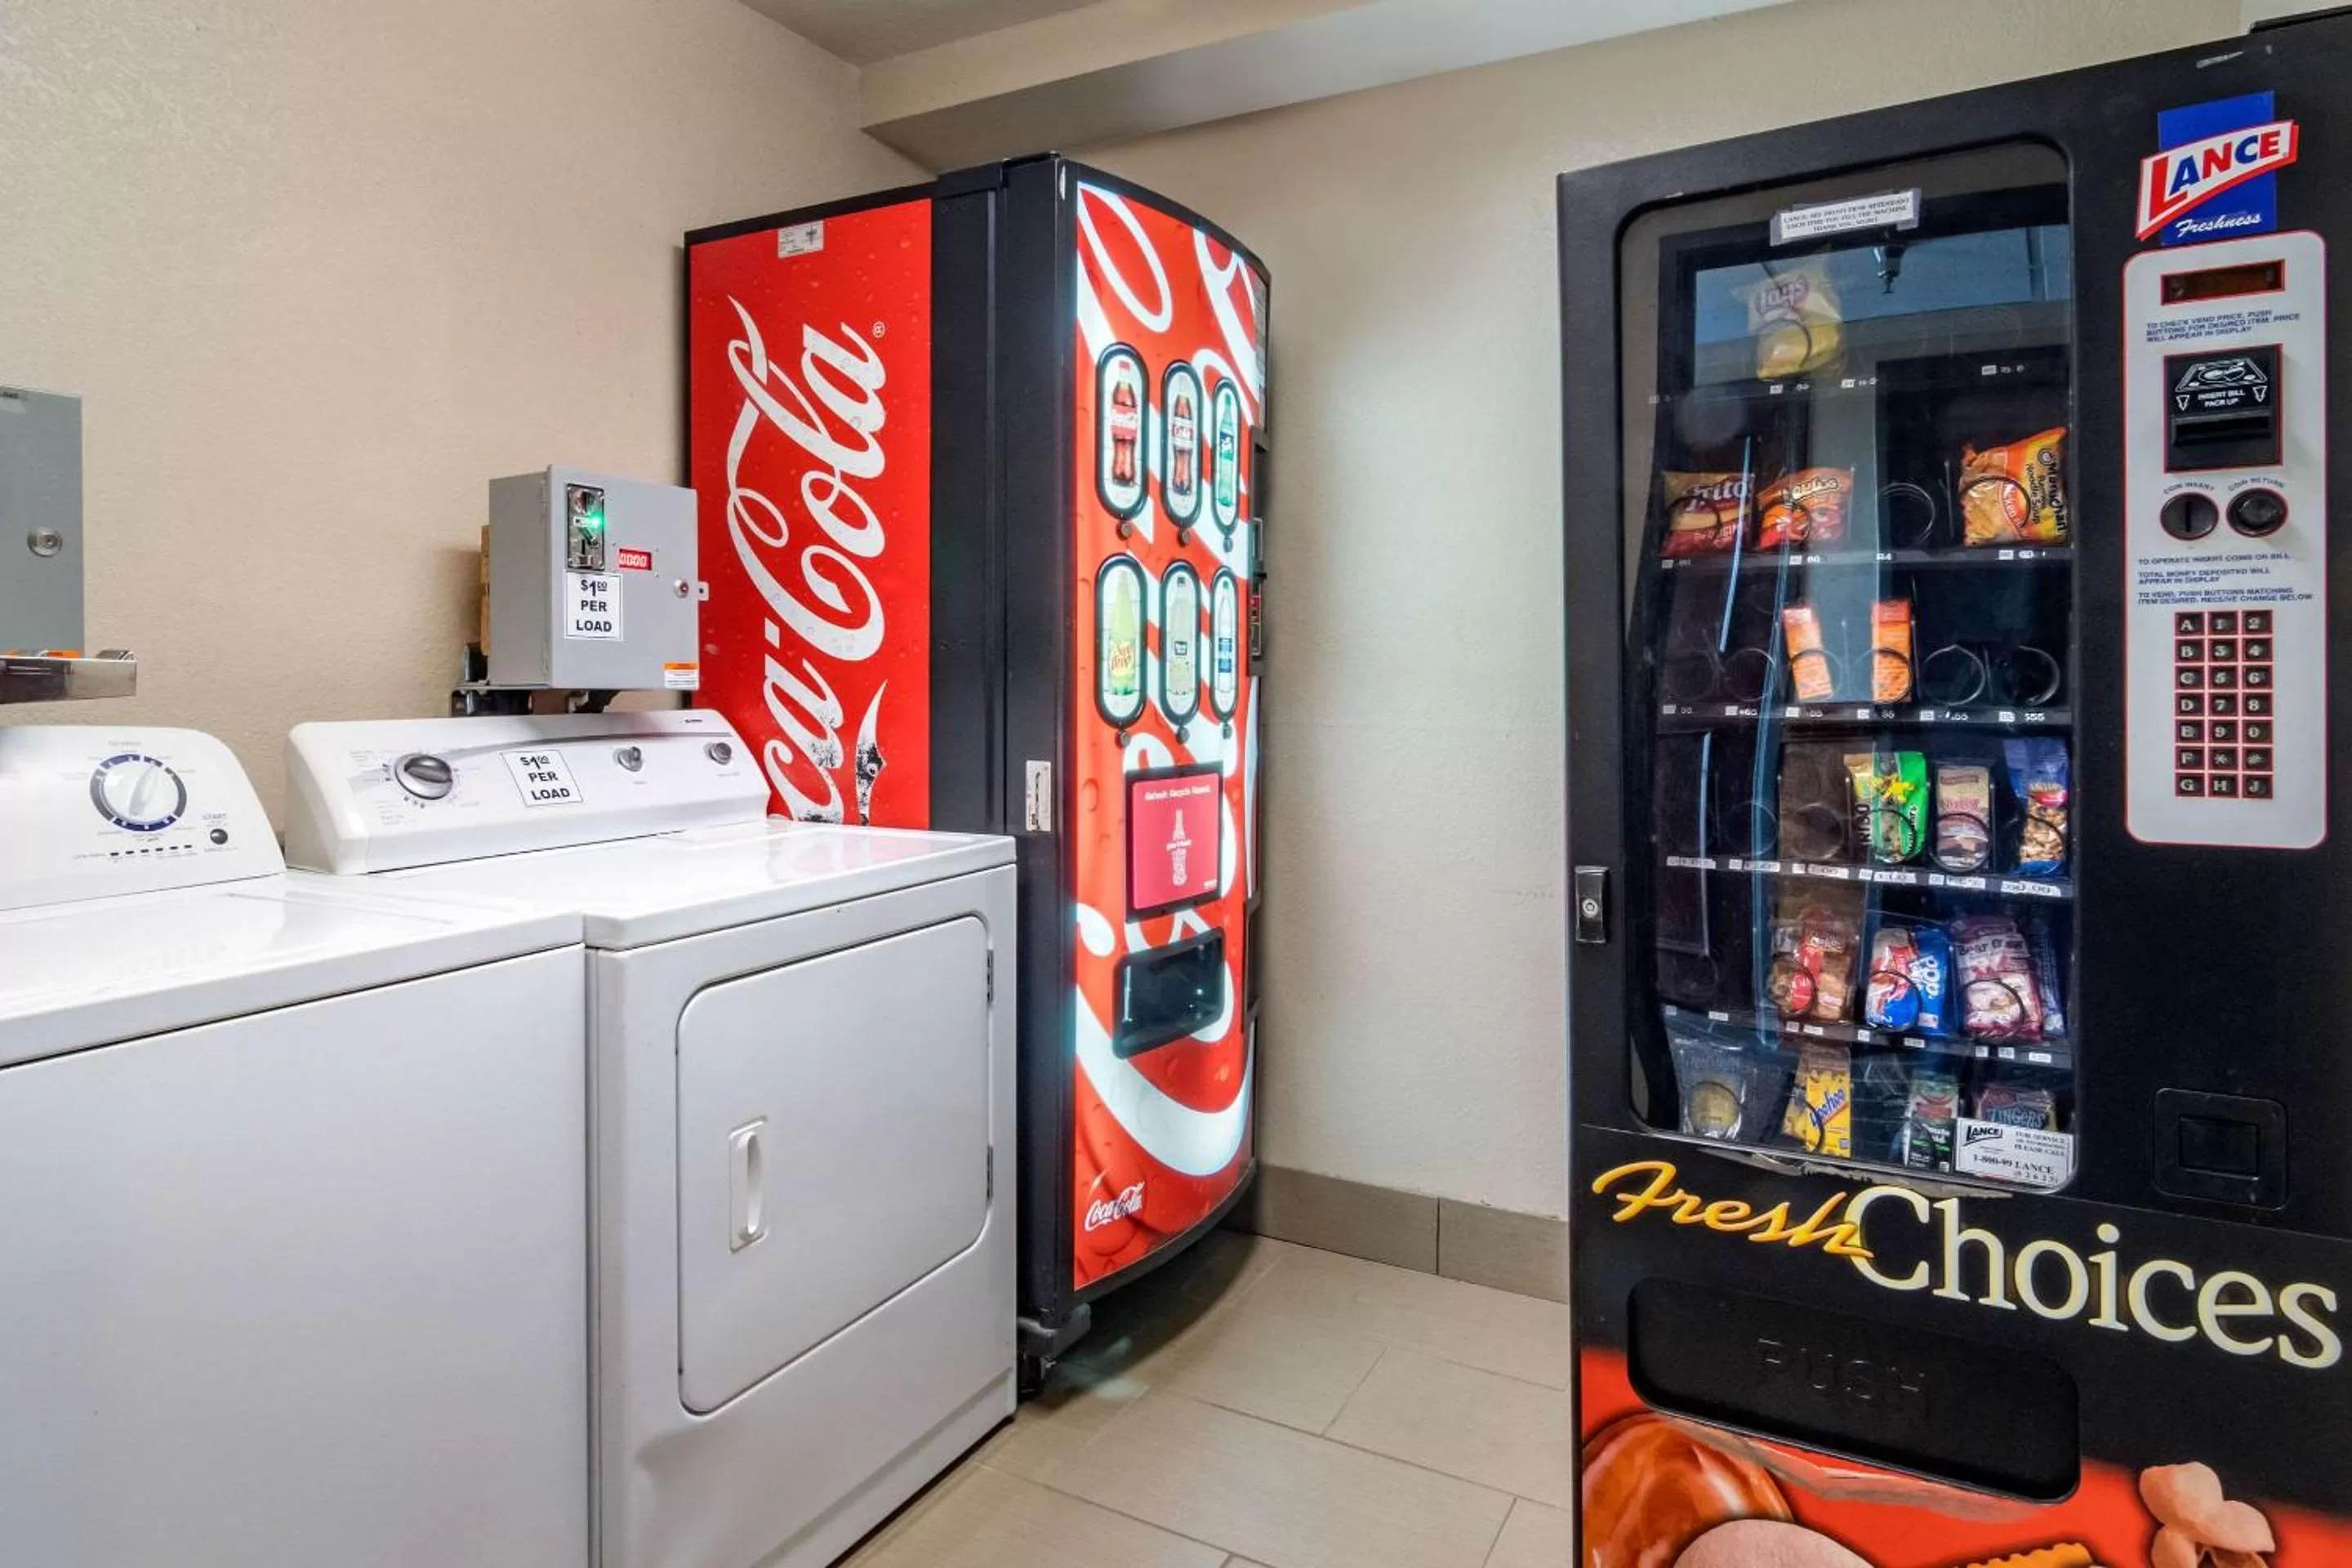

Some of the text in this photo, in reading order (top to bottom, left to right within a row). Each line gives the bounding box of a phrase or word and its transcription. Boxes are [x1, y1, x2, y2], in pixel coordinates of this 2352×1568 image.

[2149, 130, 2281, 221] LANCE
[2176, 213, 2262, 238] Freshness
[2228, 389, 2246, 398] BILL
[2026, 463, 2041, 524] Noodle Soup
[2151, 557, 2189, 565] OPERATE
[2198, 568, 2247, 577] DEPOSITED
[2204, 589, 2245, 597] BUTTONS
[2240, 595, 2277, 603] CHANGE
[581, 600, 607, 612] PER
[576, 620, 612, 633] LOAD
[2180, 621, 2193, 630] A
[2247, 617, 2261, 630] 2
[2180, 645, 2261, 658] B 3 4
[2180, 672, 2260, 684] C 5 6
[2180, 699, 2260, 710] D 7 8
[2215, 727, 2225, 738] 9
[2181, 752, 2194, 764] F
[528, 771, 559, 783] PER
[2180, 779, 2259, 792] G H J
[531, 787, 570, 801] LOAD
[1967, 1125, 1999, 1142] LANCE
[1973, 1154, 2054, 1174] 1-800-99 LANCE
[1592, 1160, 1873, 1258] Fresh
[1845, 1185, 2344, 1370] Choices
